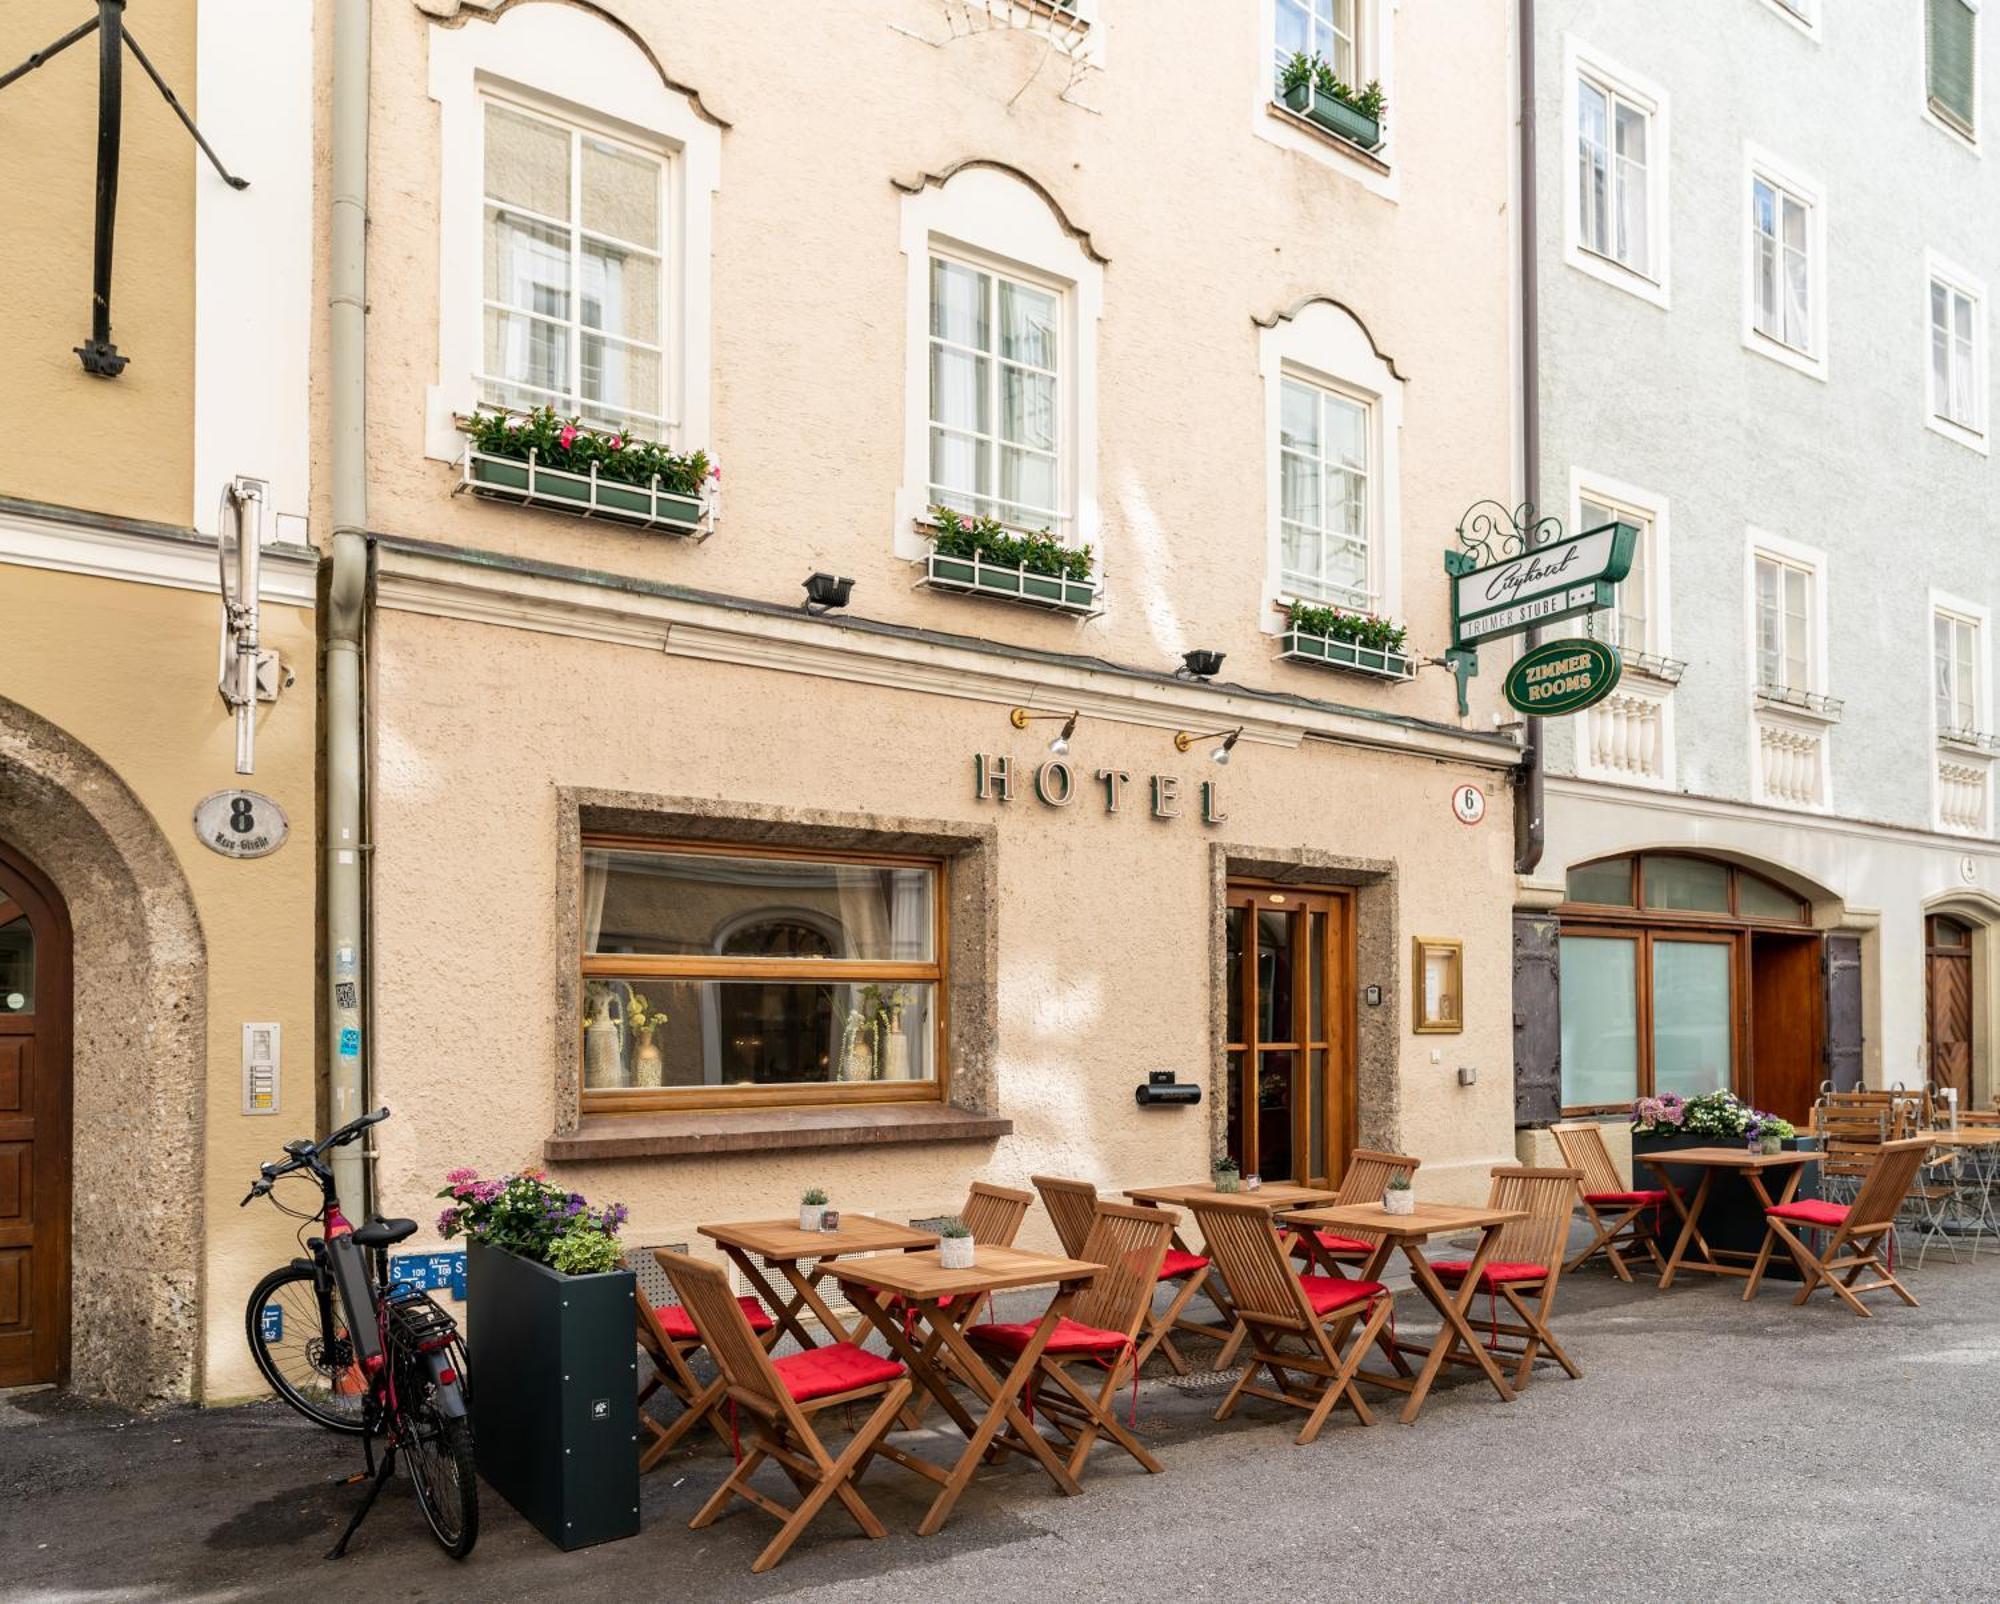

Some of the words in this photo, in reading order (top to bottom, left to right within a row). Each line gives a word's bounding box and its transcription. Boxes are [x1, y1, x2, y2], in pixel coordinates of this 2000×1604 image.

[1485, 545, 1579, 600] Cityhotel
[1467, 611, 1514, 635] TRUMER
[1519, 598, 1557, 621] STUBE
[1526, 653, 1592, 684] ZIMMER
[1528, 673, 1591, 701] ROOMS
[975, 753, 1228, 824] HOTEL
[1465, 788, 1474, 810] 6
[230, 797, 254, 834] 8
[393, 1266, 401, 1279] S
[411, 1268, 426, 1277] 100
[455, 1261, 463, 1273] S
